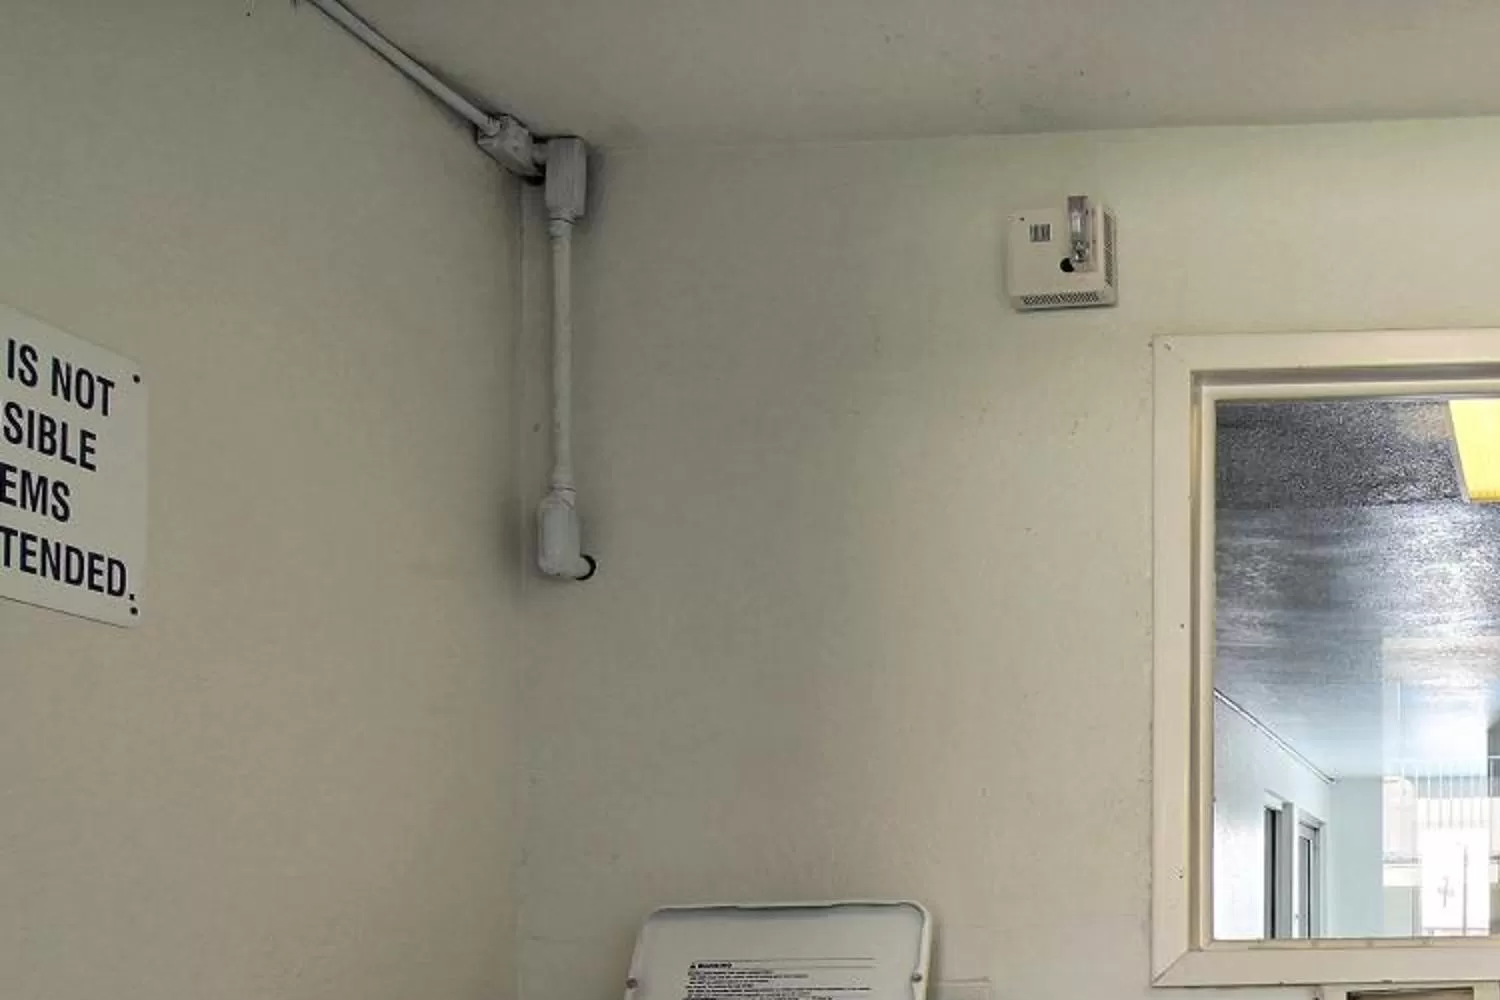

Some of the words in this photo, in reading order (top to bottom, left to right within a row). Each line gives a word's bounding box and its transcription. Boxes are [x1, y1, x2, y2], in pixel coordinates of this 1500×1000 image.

[6, 338, 39, 388] IS
[51, 356, 116, 417] NOT
[3, 400, 98, 472] SIBLE
[0, 461, 71, 523] EMS
